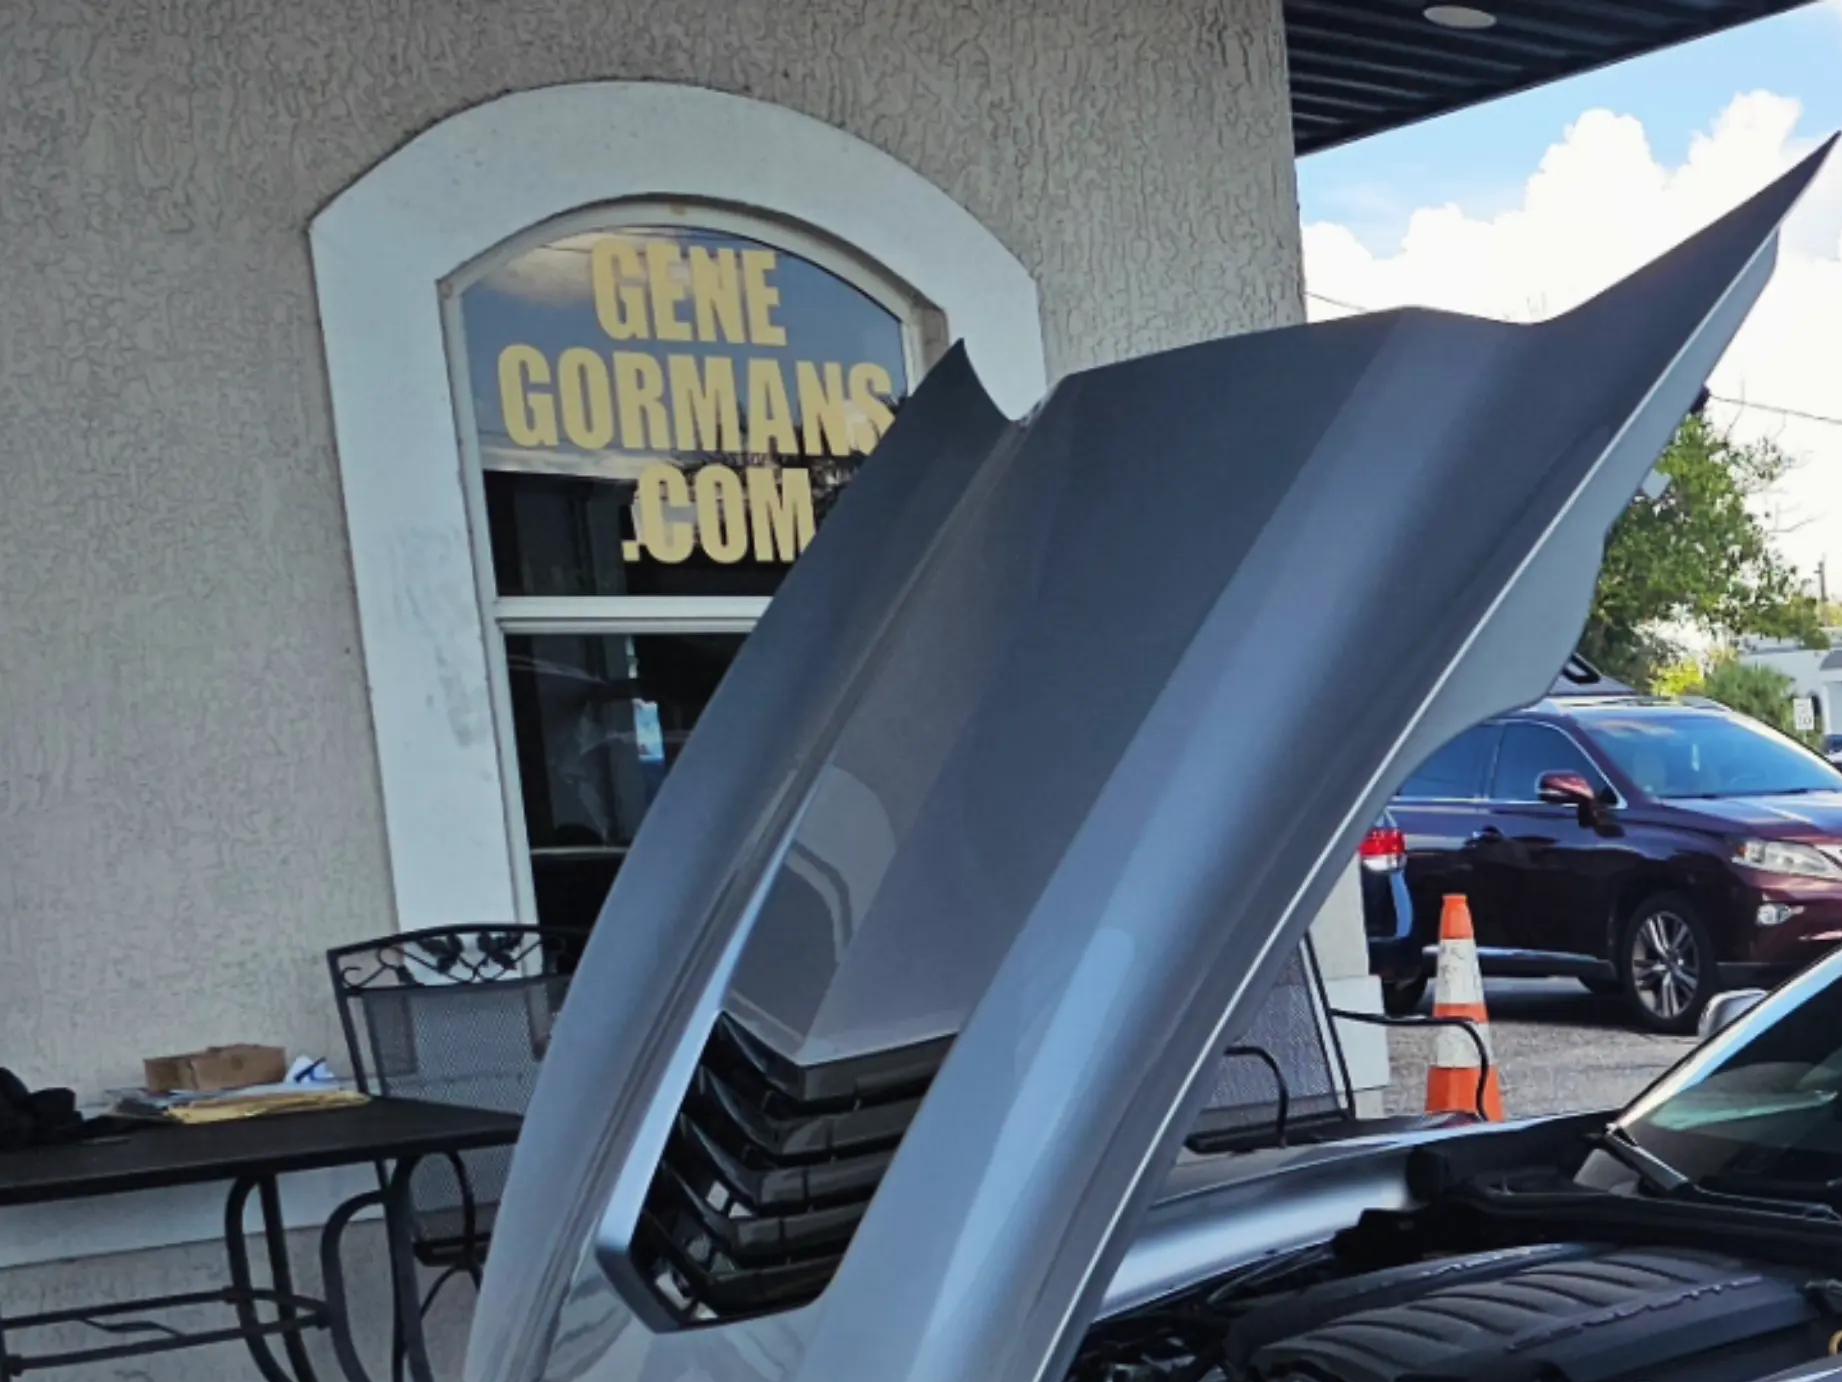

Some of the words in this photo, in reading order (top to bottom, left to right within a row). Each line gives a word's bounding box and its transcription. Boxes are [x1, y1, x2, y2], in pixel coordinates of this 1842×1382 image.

[592, 236, 787, 346] GENE
[499, 344, 897, 456] GORMANS
[621, 463, 817, 564] .COM
